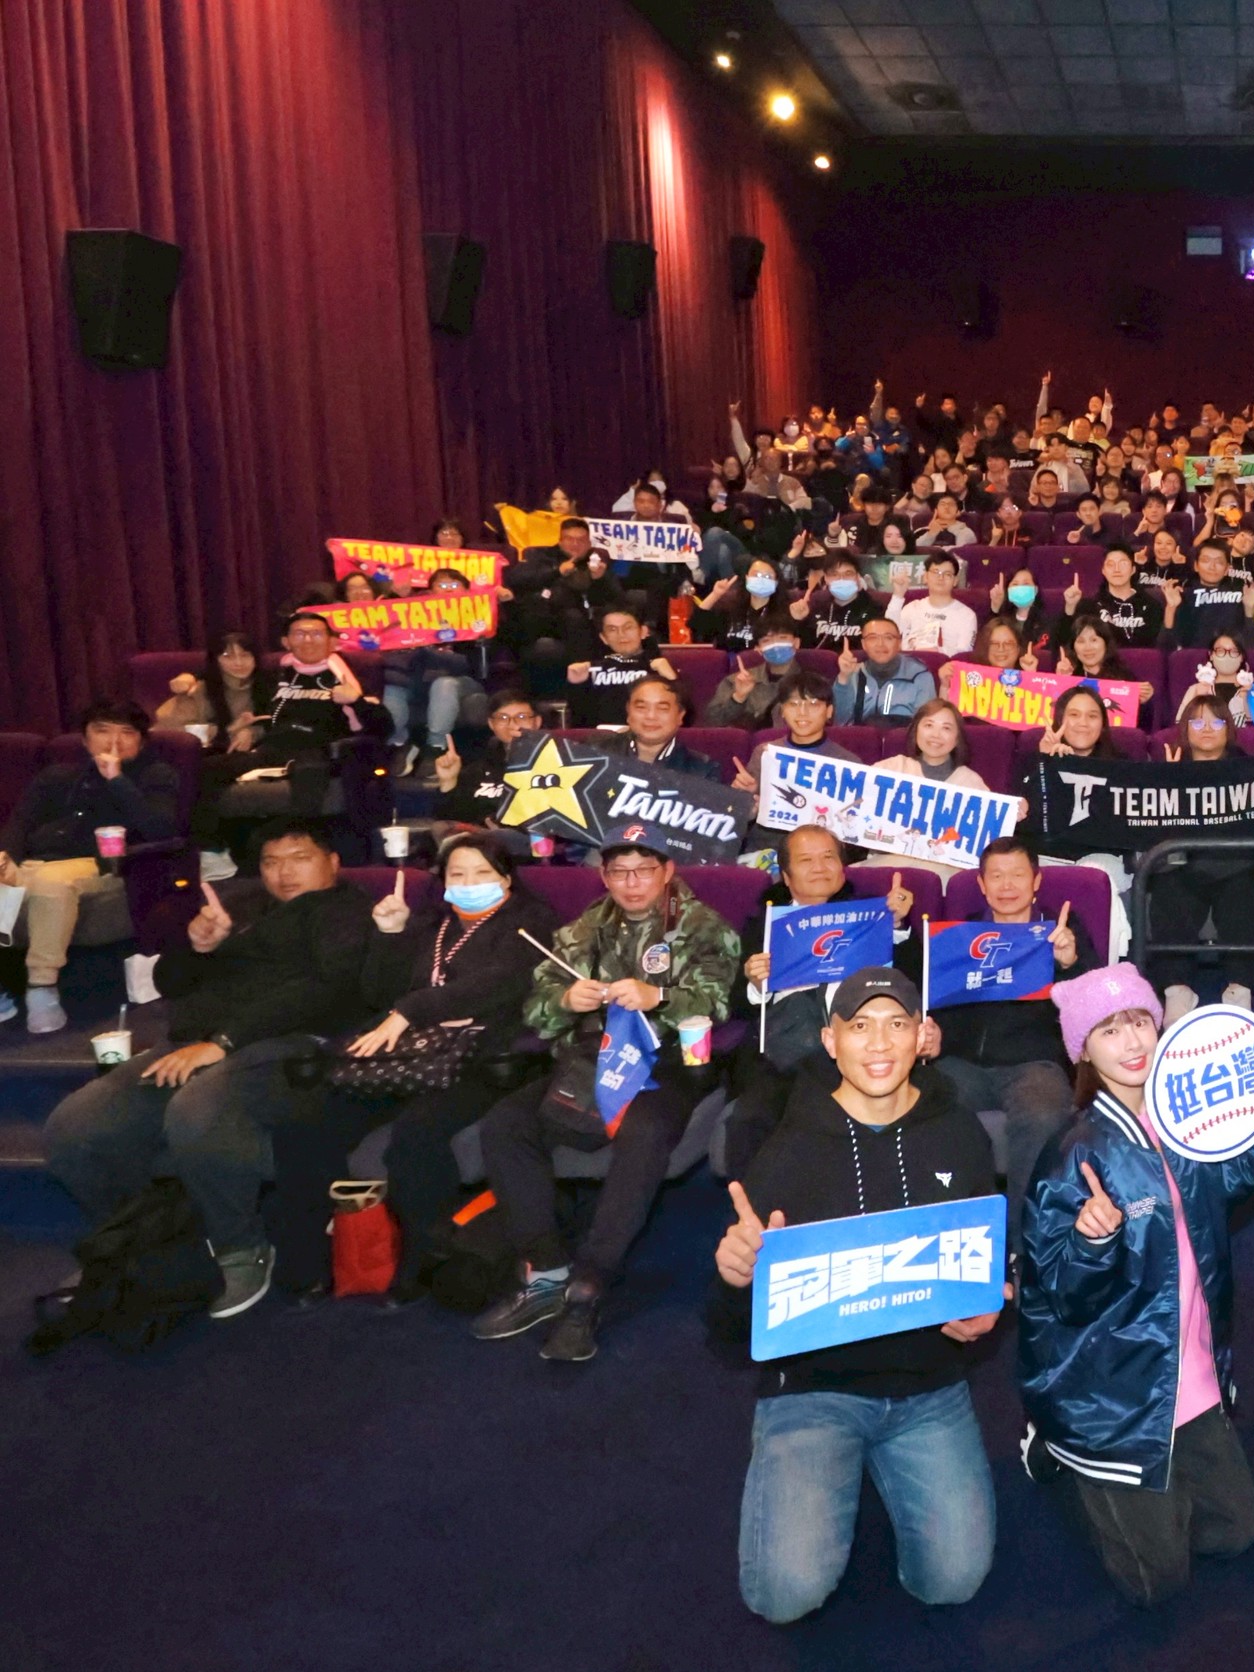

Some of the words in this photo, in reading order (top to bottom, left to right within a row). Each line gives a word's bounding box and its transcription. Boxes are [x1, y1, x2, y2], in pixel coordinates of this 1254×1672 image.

[589, 521, 639, 542] TEAM
[643, 525, 702, 553] TAIWA
[342, 542, 405, 565] TEAM
[408, 548, 496, 585] TAIWAN
[391, 594, 492, 632] TAIWAN
[1193, 588, 1243, 608] Taiwan
[607, 773, 738, 842] Taiwan
[769, 808, 799, 823] 2024
[775, 752, 867, 809] TEAM
[874, 773, 1010, 855] TAIWAN
[1110, 786, 1180, 817] TEAM
[1127, 818, 1159, 827] TAIWAN
[1161, 818, 1200, 827] NATIONAL
[1203, 814, 1243, 826] BASEBALL
[767, 1225, 993, 1330] 冠軍之路
[839, 1296, 887, 1317] HERO!
[891, 1287, 932, 1307] HITO!
